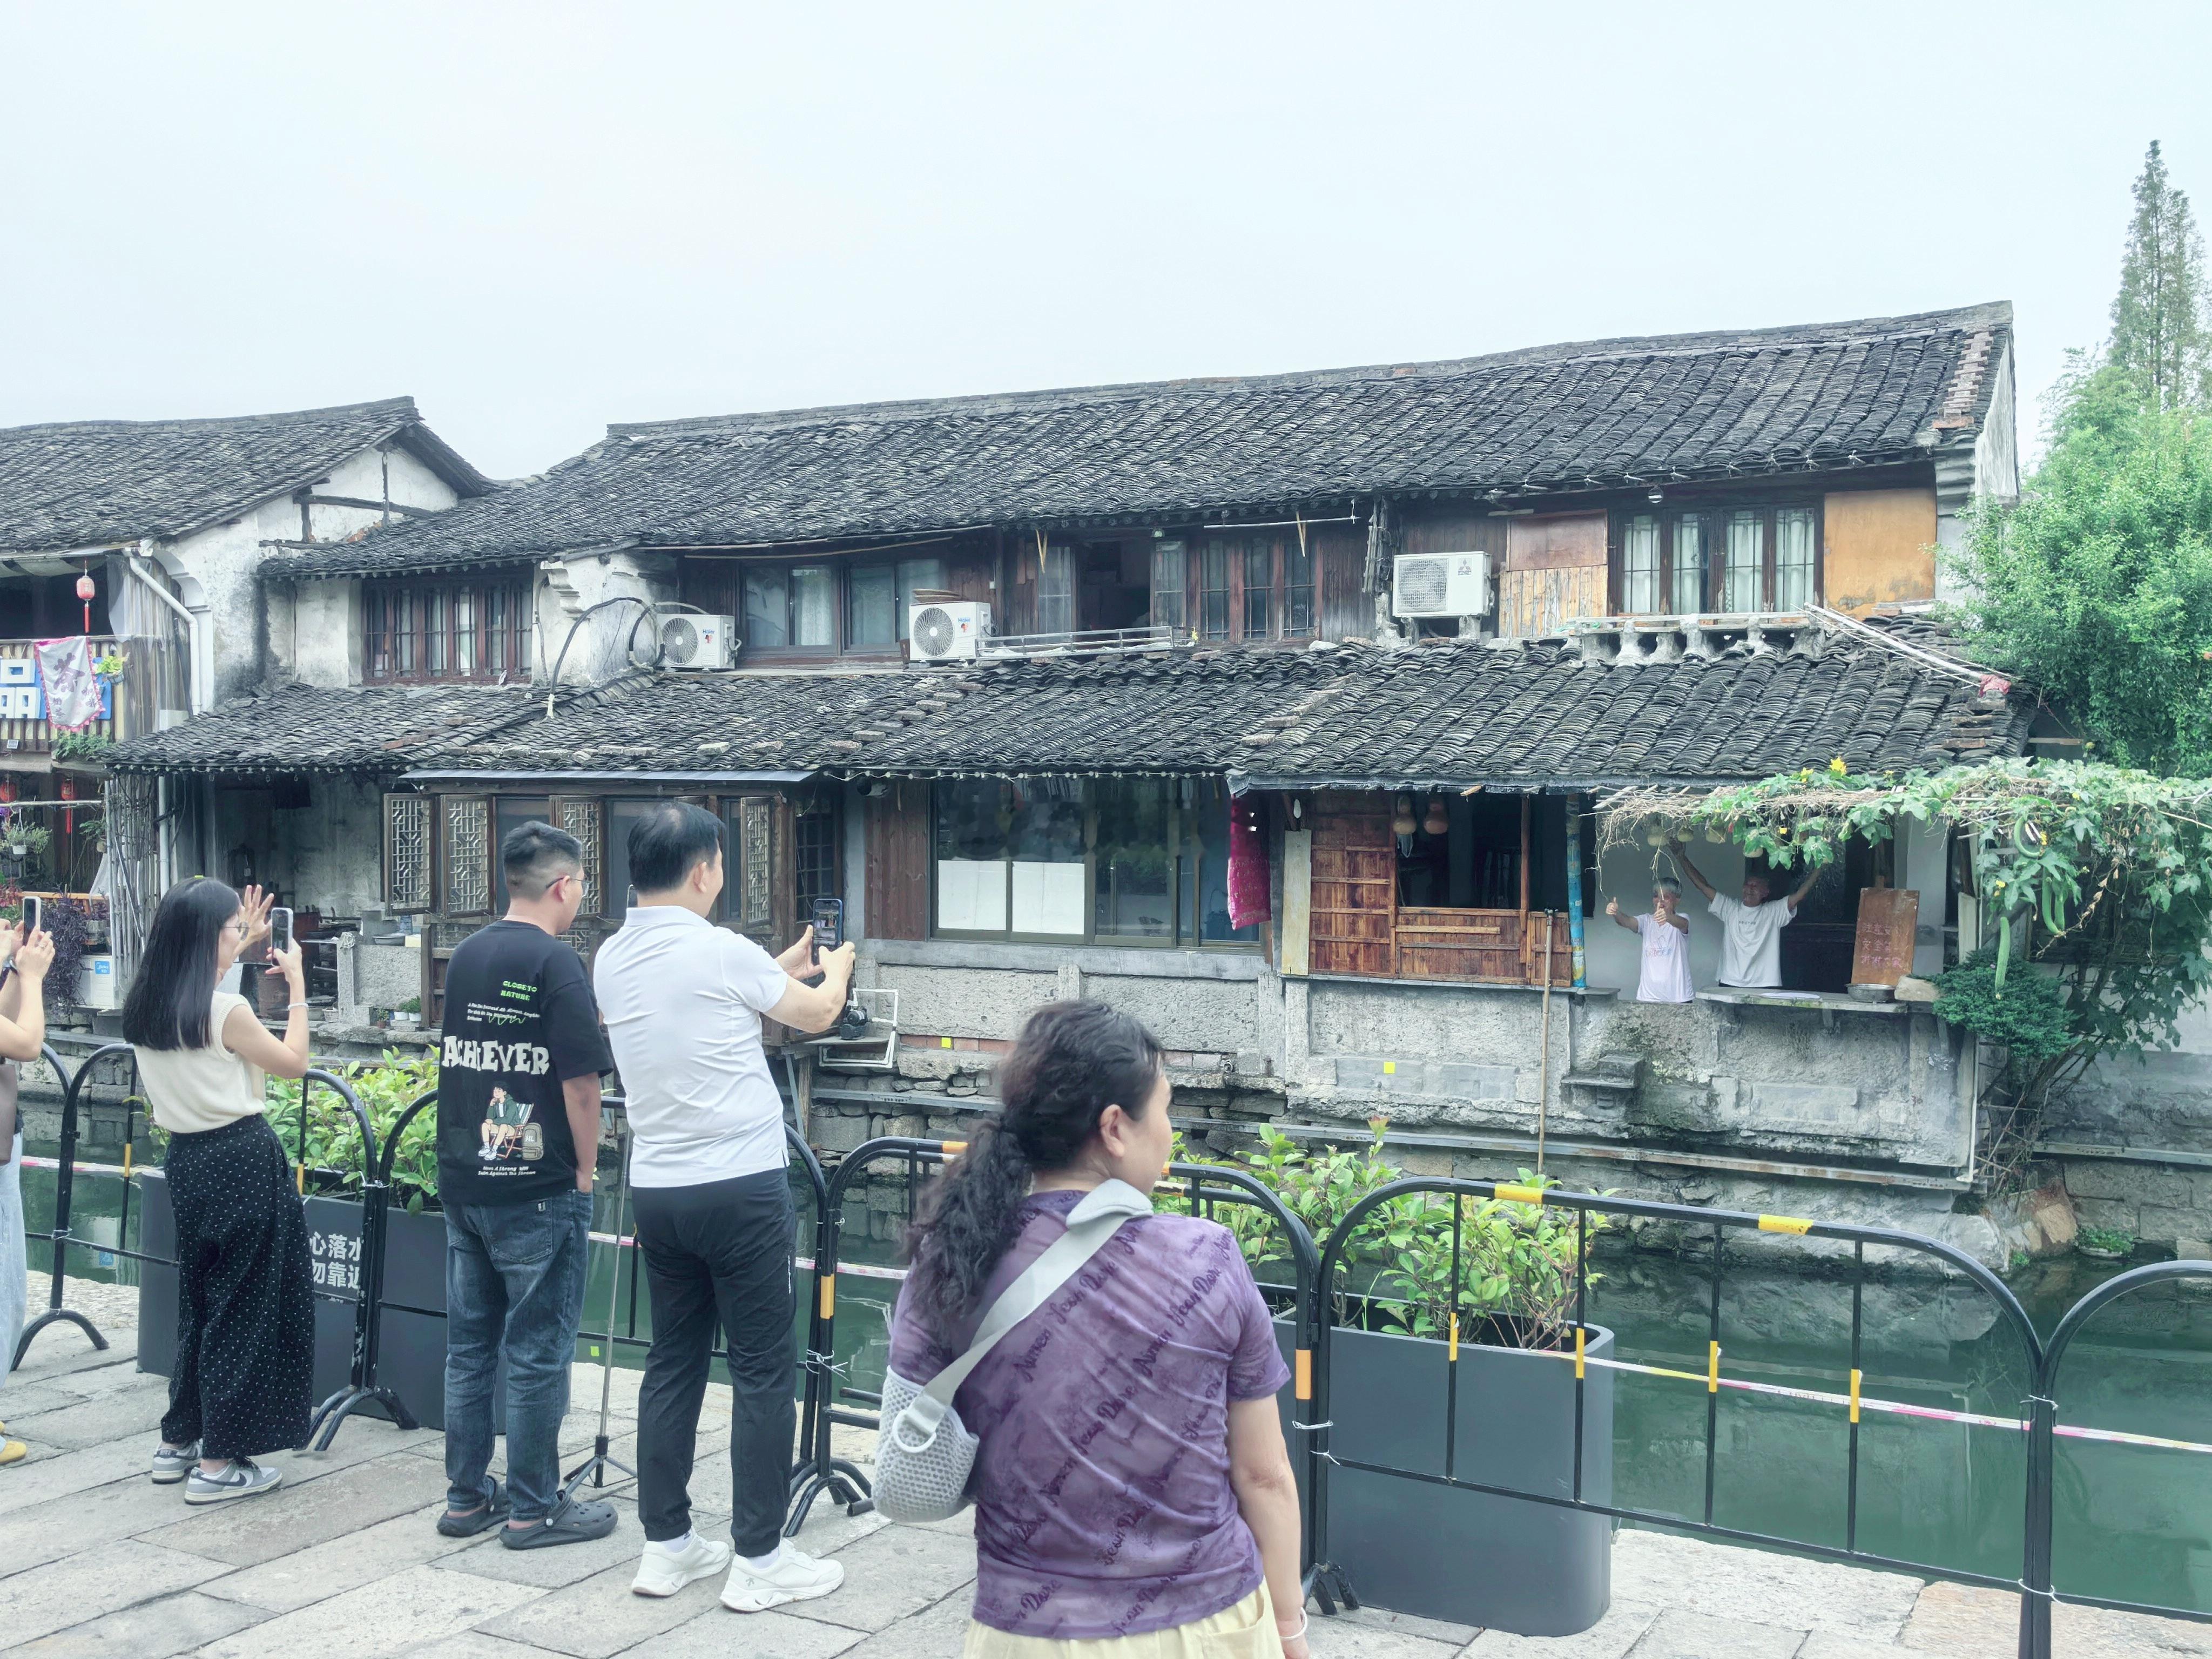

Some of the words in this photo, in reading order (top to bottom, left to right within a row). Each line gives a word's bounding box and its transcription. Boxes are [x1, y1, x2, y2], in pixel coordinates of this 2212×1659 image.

[53, 652, 85, 692] 茶
[500, 990, 531, 1001] NATURE
[503, 981, 527, 991] CLOSE
[442, 1035, 550, 1075] ACHIEVER
[309, 1231, 362, 1262] 心落水
